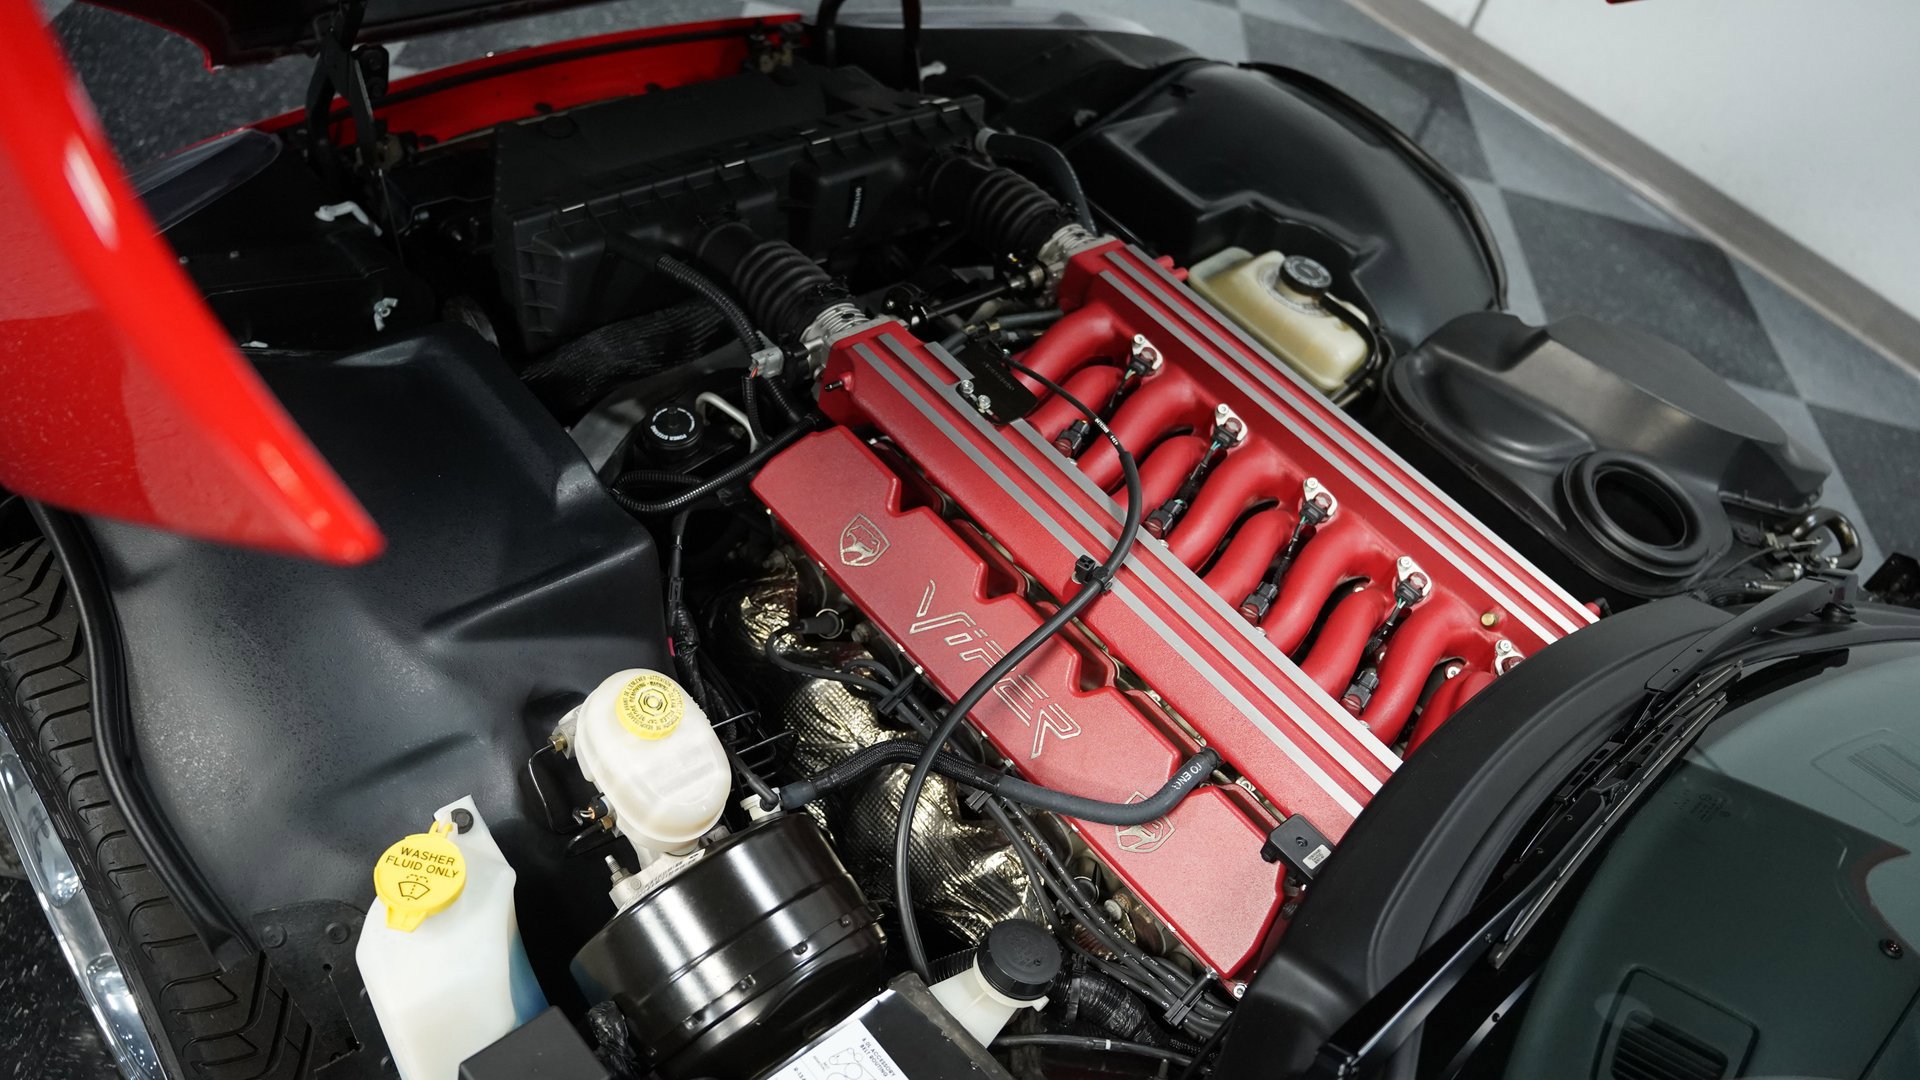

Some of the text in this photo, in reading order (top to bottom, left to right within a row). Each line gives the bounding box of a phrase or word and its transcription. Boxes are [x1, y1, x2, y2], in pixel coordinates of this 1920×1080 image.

[385, 855, 460, 879] FLUID ONLY
[400, 846, 455, 866] WASHER
[860, 1044, 889, 1077] BELT ROUTING
[871, 1048, 896, 1077] ACCESSORY
